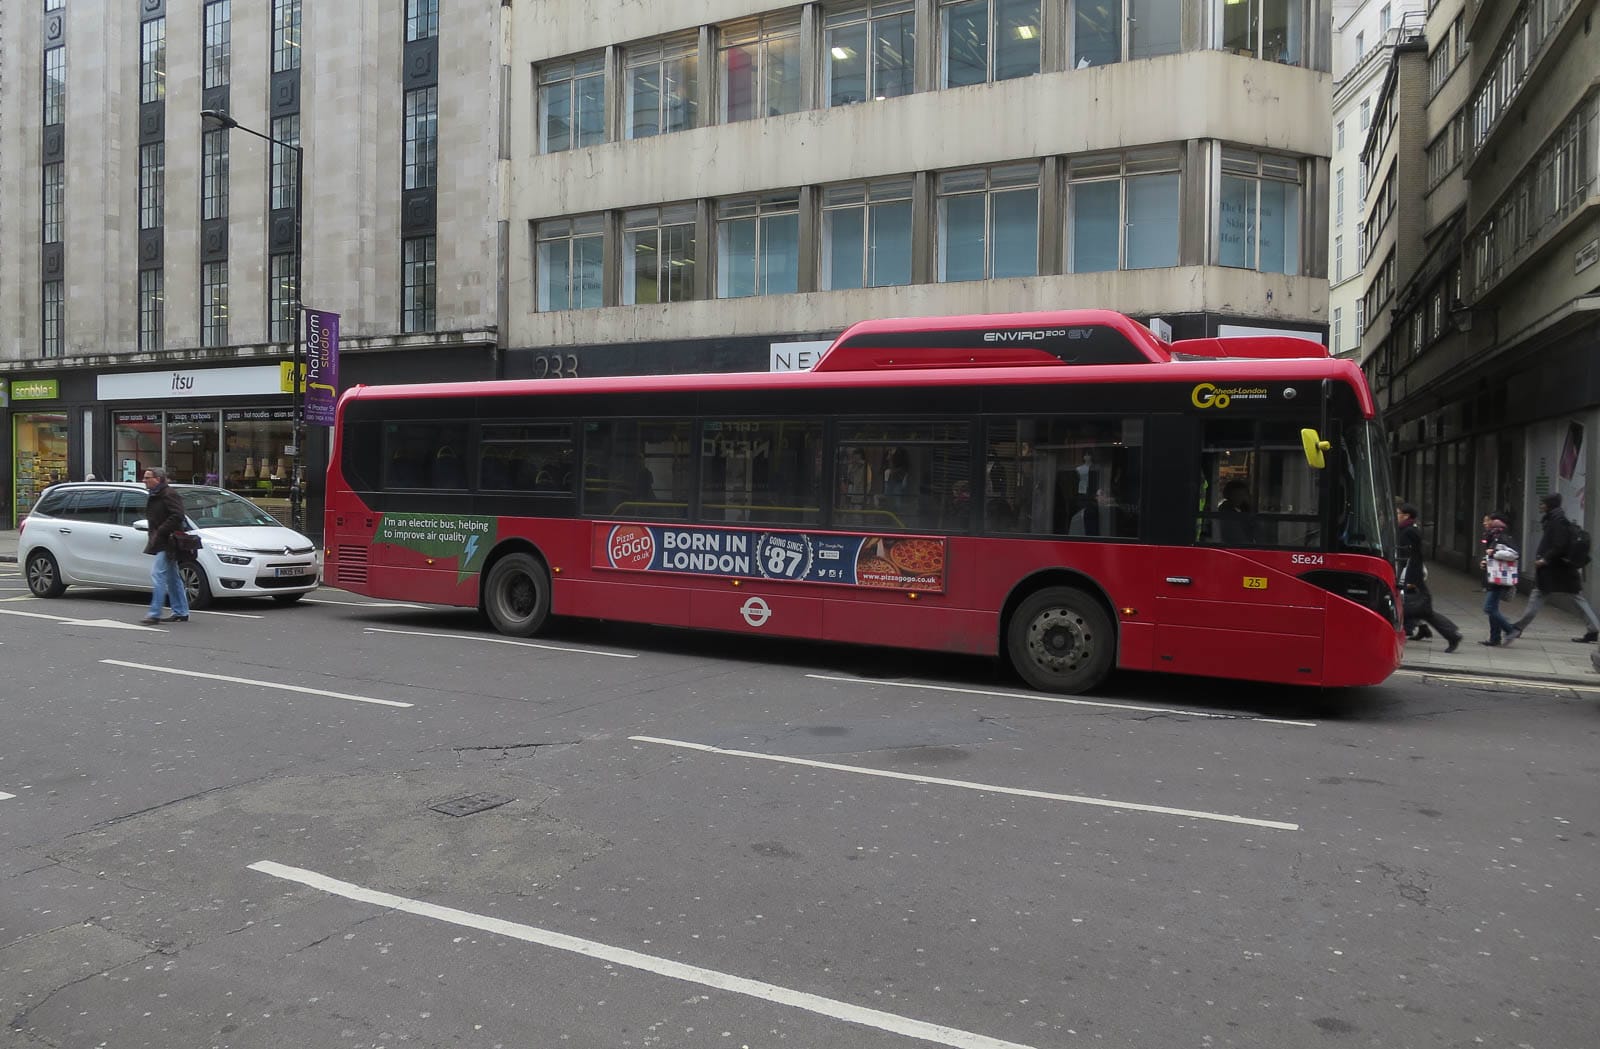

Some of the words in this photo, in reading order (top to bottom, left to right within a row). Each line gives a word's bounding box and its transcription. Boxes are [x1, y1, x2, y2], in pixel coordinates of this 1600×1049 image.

[1068, 328, 1094, 339] EV
[308, 314, 320, 379] hairform
[320, 328, 330, 368] studio
[775, 351, 821, 369] NE
[172, 372, 194, 390] itsu
[287, 368, 306, 381] itu
[1191, 382, 1231, 409] Go
[1212, 387, 1267, 395] Ahead-London
[384, 517, 396, 526] I'm
[398, 519, 407, 527] an
[408, 518, 438, 528] electric
[439, 519, 457, 530] bus,
[458, 519, 489, 532] helping
[384, 530, 393, 538] to
[394, 530, 425, 541] improve
[426, 531, 438, 540] air
[438, 532, 467, 543] quality
[615, 532, 635, 545] Pizza
[663, 531, 720, 551] BORN
[726, 534, 747, 553] IN
[769, 536, 787, 548] GOING
[786, 540, 804, 552] SINCE
[612, 536, 651, 560] GOGO
[631, 551, 651, 563] .co.uk
[662, 551, 750, 574] LONDON
[1291, 554, 1324, 565] SEe24
[863, 574, 936, 583] www.pizzagogo.co.uk
[1247, 578, 1262, 588] 25
